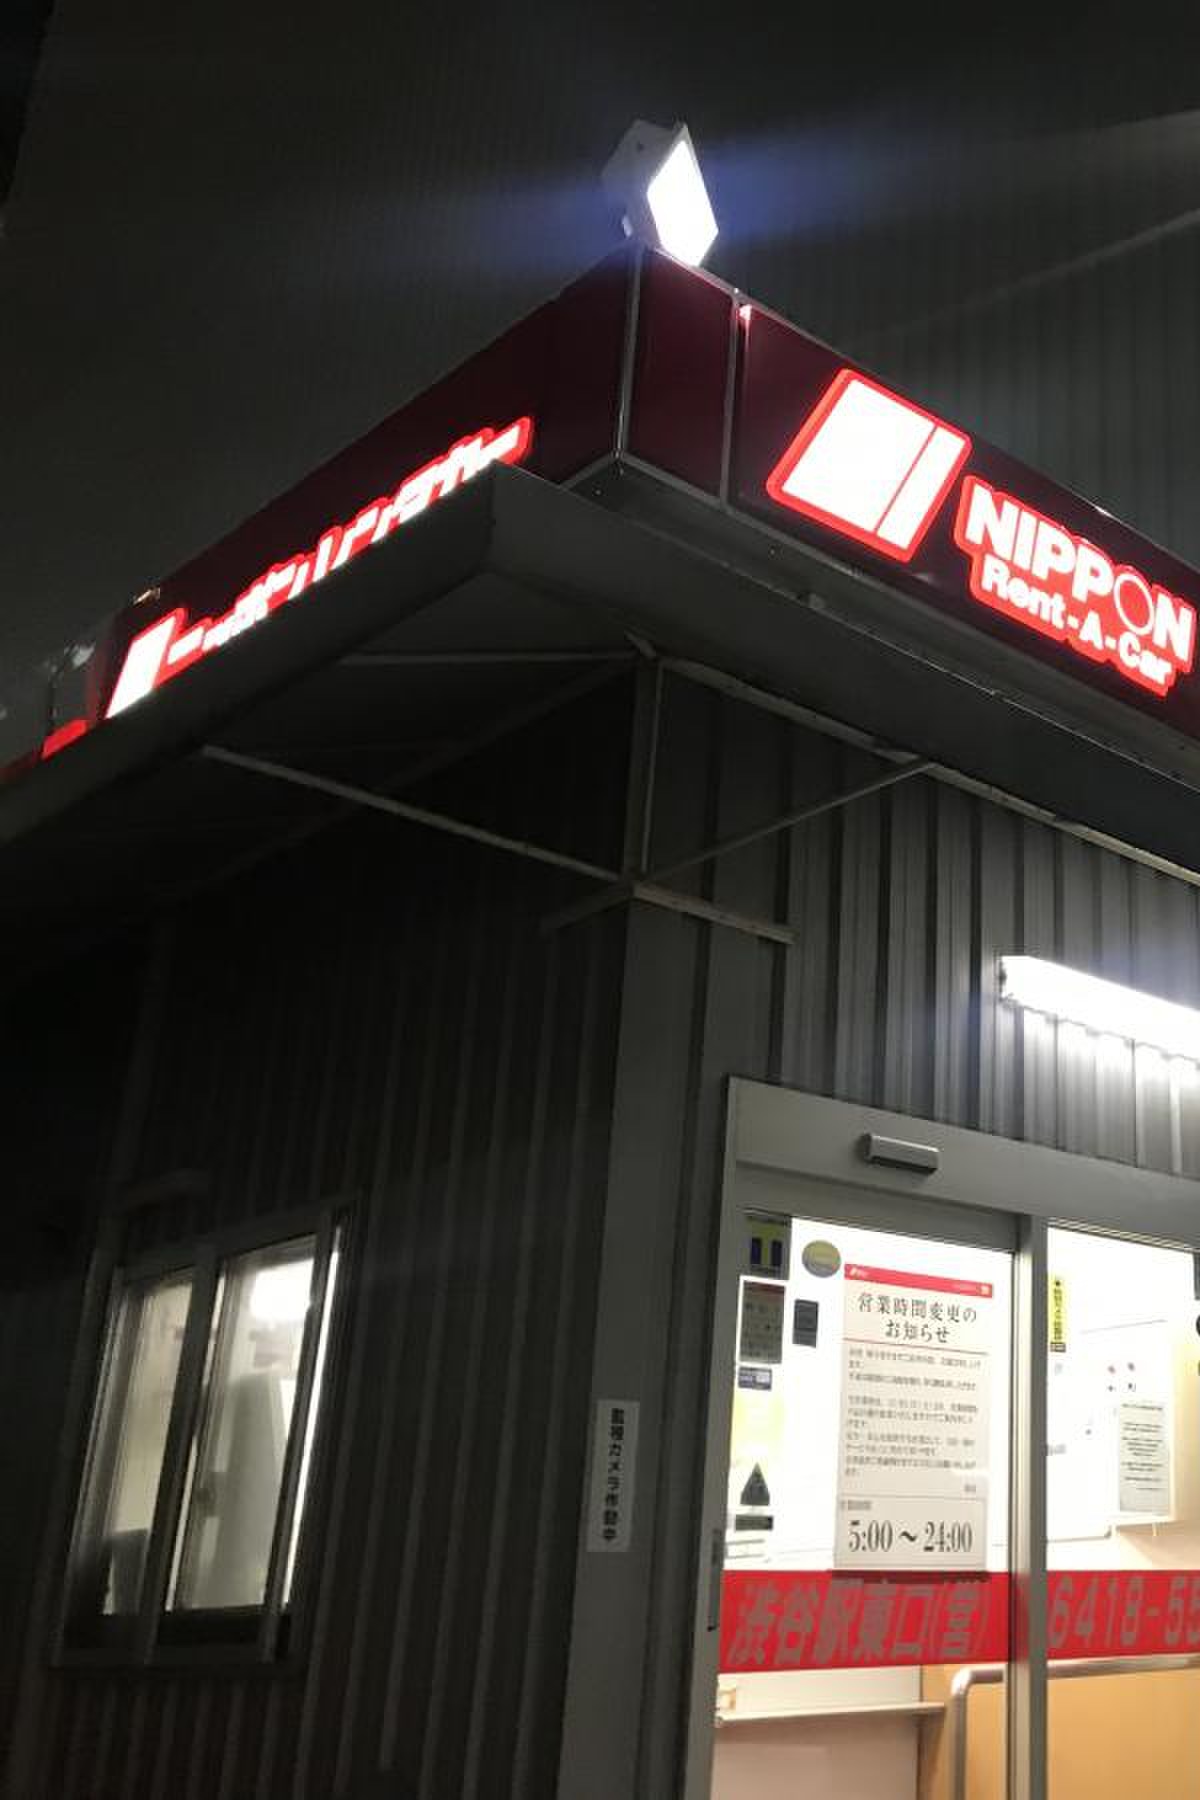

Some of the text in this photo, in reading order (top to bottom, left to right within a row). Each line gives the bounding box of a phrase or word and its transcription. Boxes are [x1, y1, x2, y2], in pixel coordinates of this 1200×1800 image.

[964, 483, 1194, 663] NIPPON
[981, 553, 1173, 685] Rent-A-Car
[857, 1292, 977, 1324] 営業時間変更の
[885, 1319, 950, 1343] お知らせ
